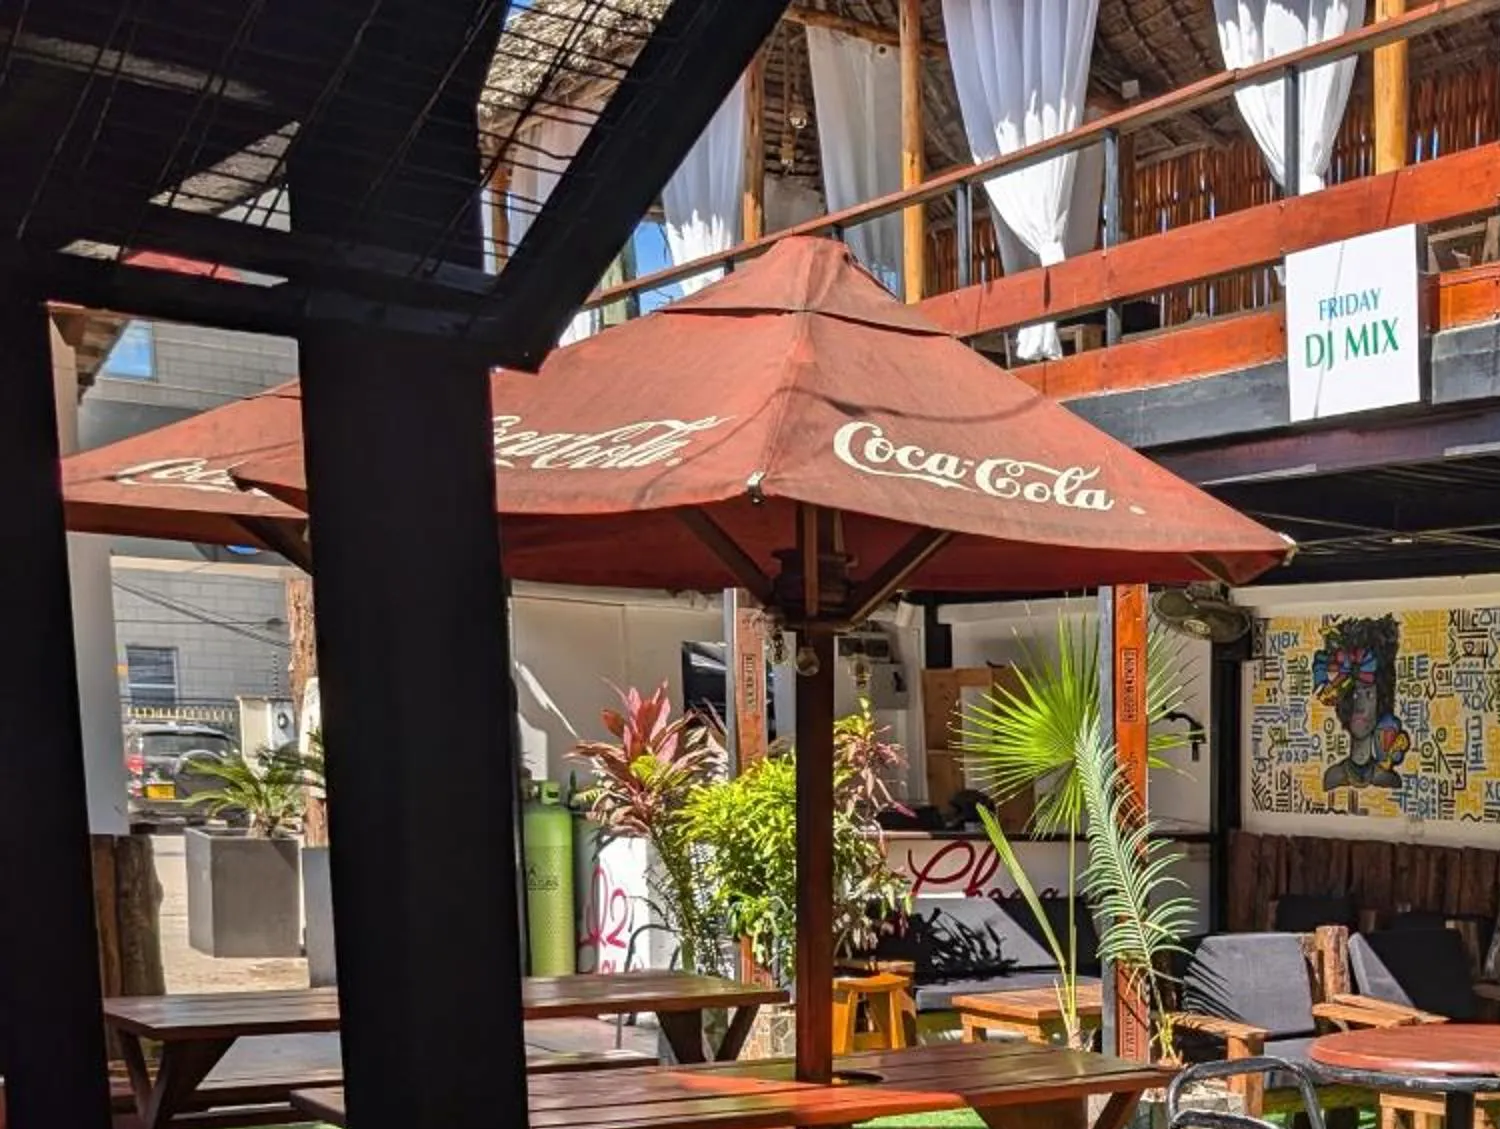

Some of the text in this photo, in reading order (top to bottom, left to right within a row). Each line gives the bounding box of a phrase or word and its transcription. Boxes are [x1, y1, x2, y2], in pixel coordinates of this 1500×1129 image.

[1318, 288, 1381, 321] FRIDAY
[1305, 317, 1399, 371] DJ MIX
[833, 421, 1115, 511] Coca-Cola
